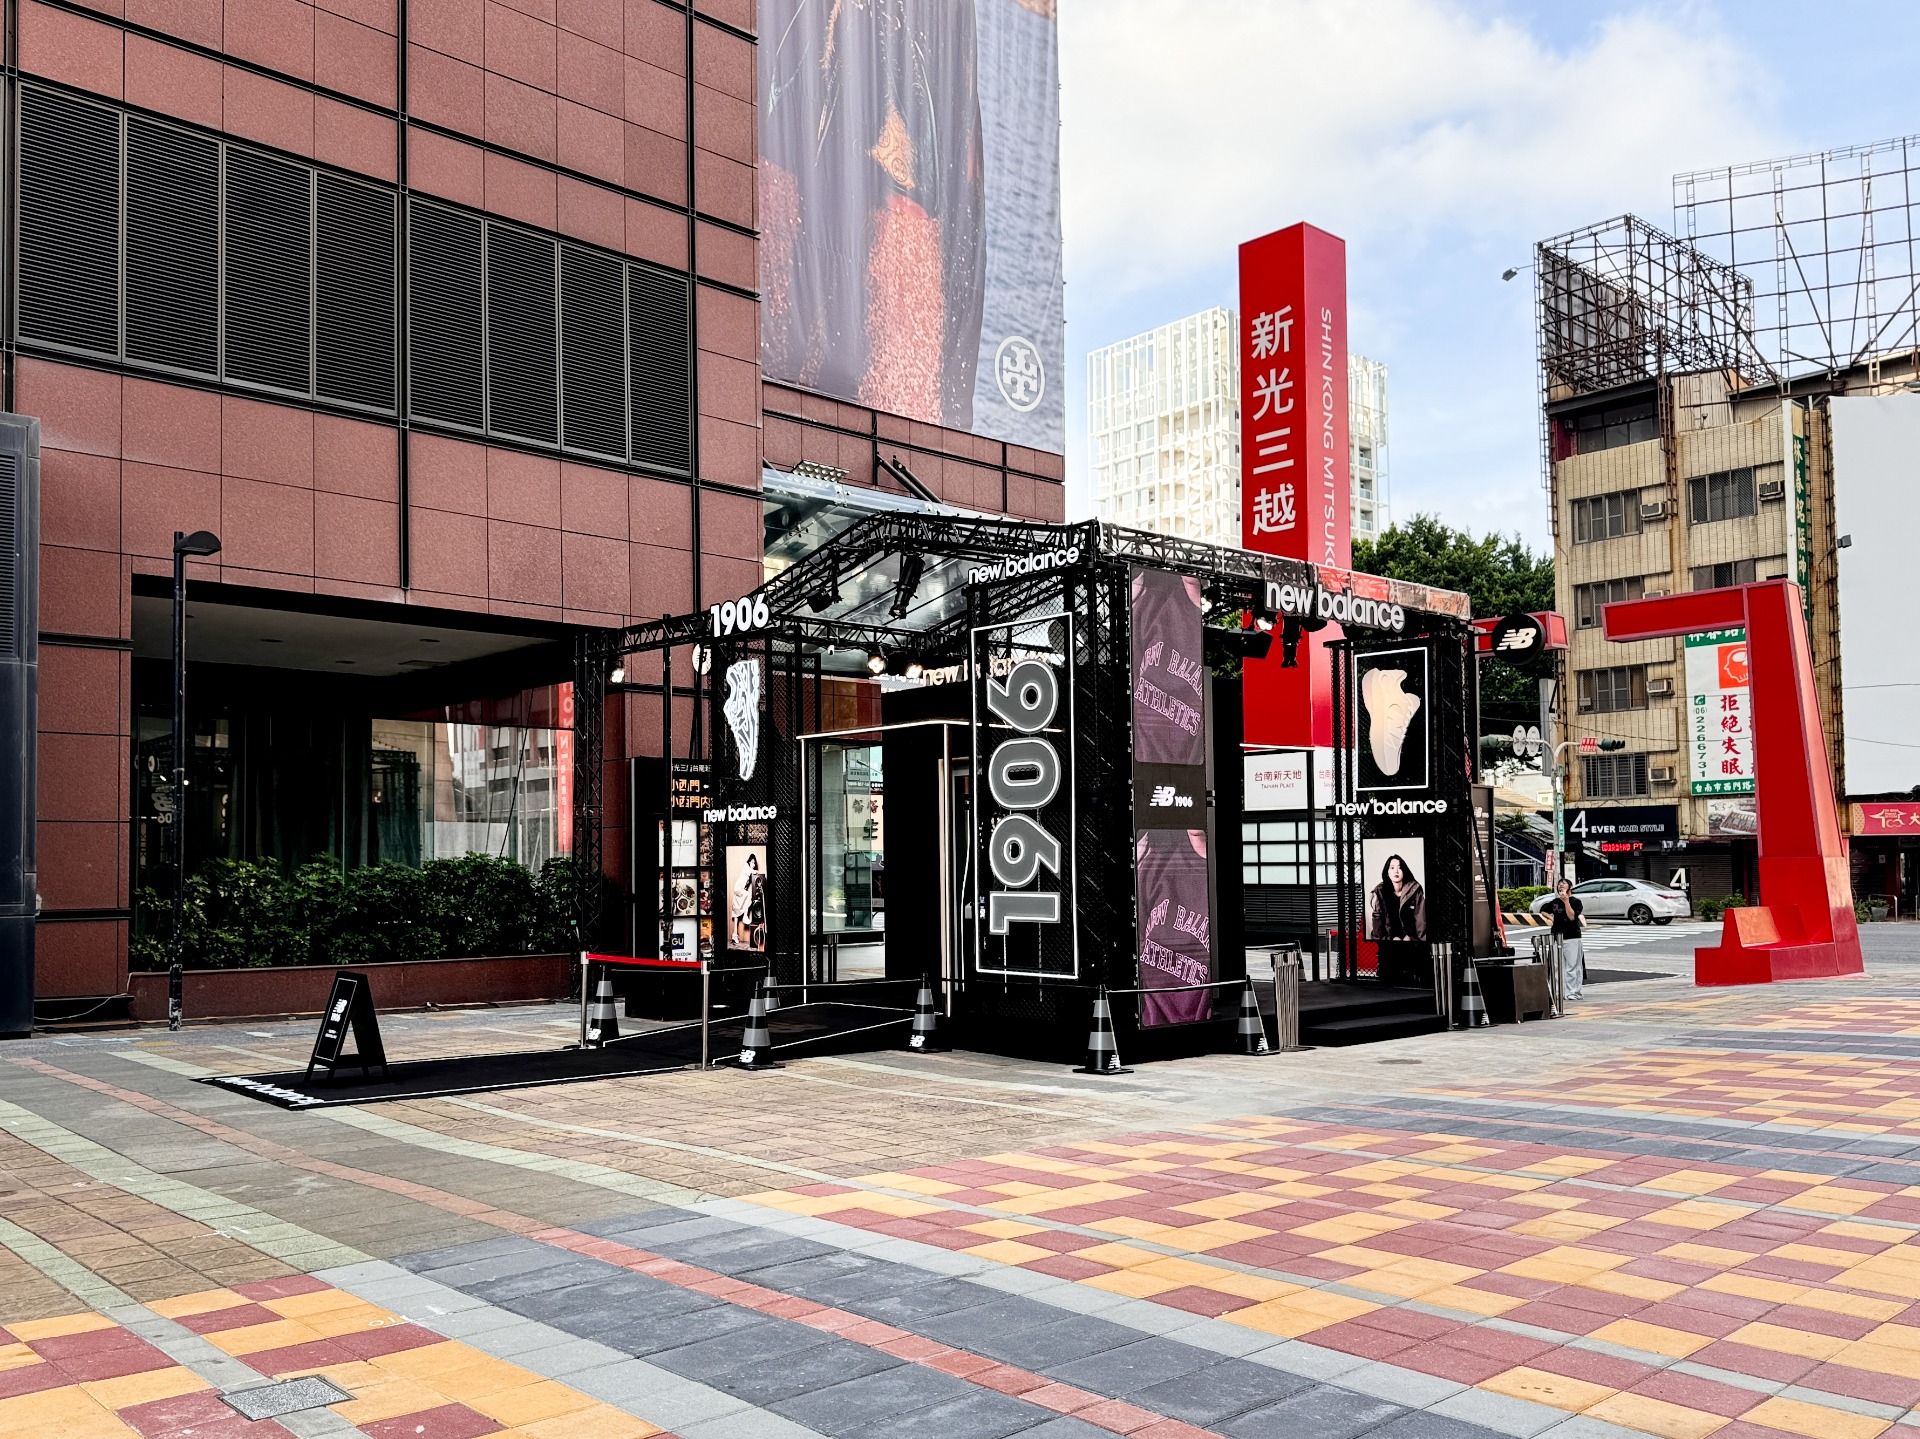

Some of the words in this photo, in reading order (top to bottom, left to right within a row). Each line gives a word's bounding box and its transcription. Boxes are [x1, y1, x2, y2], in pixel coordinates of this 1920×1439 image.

[1321, 307, 1332, 370] SHIN
[1251, 304, 1296, 536] 新光三越
[1322, 377, 1334, 450] KONG
[968, 563, 1005, 585] new
[1005, 547, 1079, 577] balance
[710, 594, 769, 637] 1906
[1266, 582, 1313, 614] new
[1317, 583, 1405, 630] balance
[1167, 649, 1203, 700] BALA
[1134, 677, 1201, 736] ATHLETICS
[986, 657, 1061, 936] 1906
[1254, 769, 1302, 781] 台南新天地
[1695, 782, 1756, 794] 台南市西門路
[703, 808, 726, 822] new
[728, 804, 777, 821] balance
[1175, 796, 1193, 808] 1906
[1335, 802, 1370, 816] new
[1373, 798, 1447, 815] balance
[1570, 810, 1588, 838] 4
[1591, 825, 1616, 834] EVER
[1618, 825, 1638, 833] HAIR
[1640, 824, 1664, 833] STYLE
[1670, 868, 1688, 889] 4
[671, 937, 684, 946] GU
[1173, 905, 1210, 952] BALA
[1140, 939, 1209, 986] ATHLETICS
